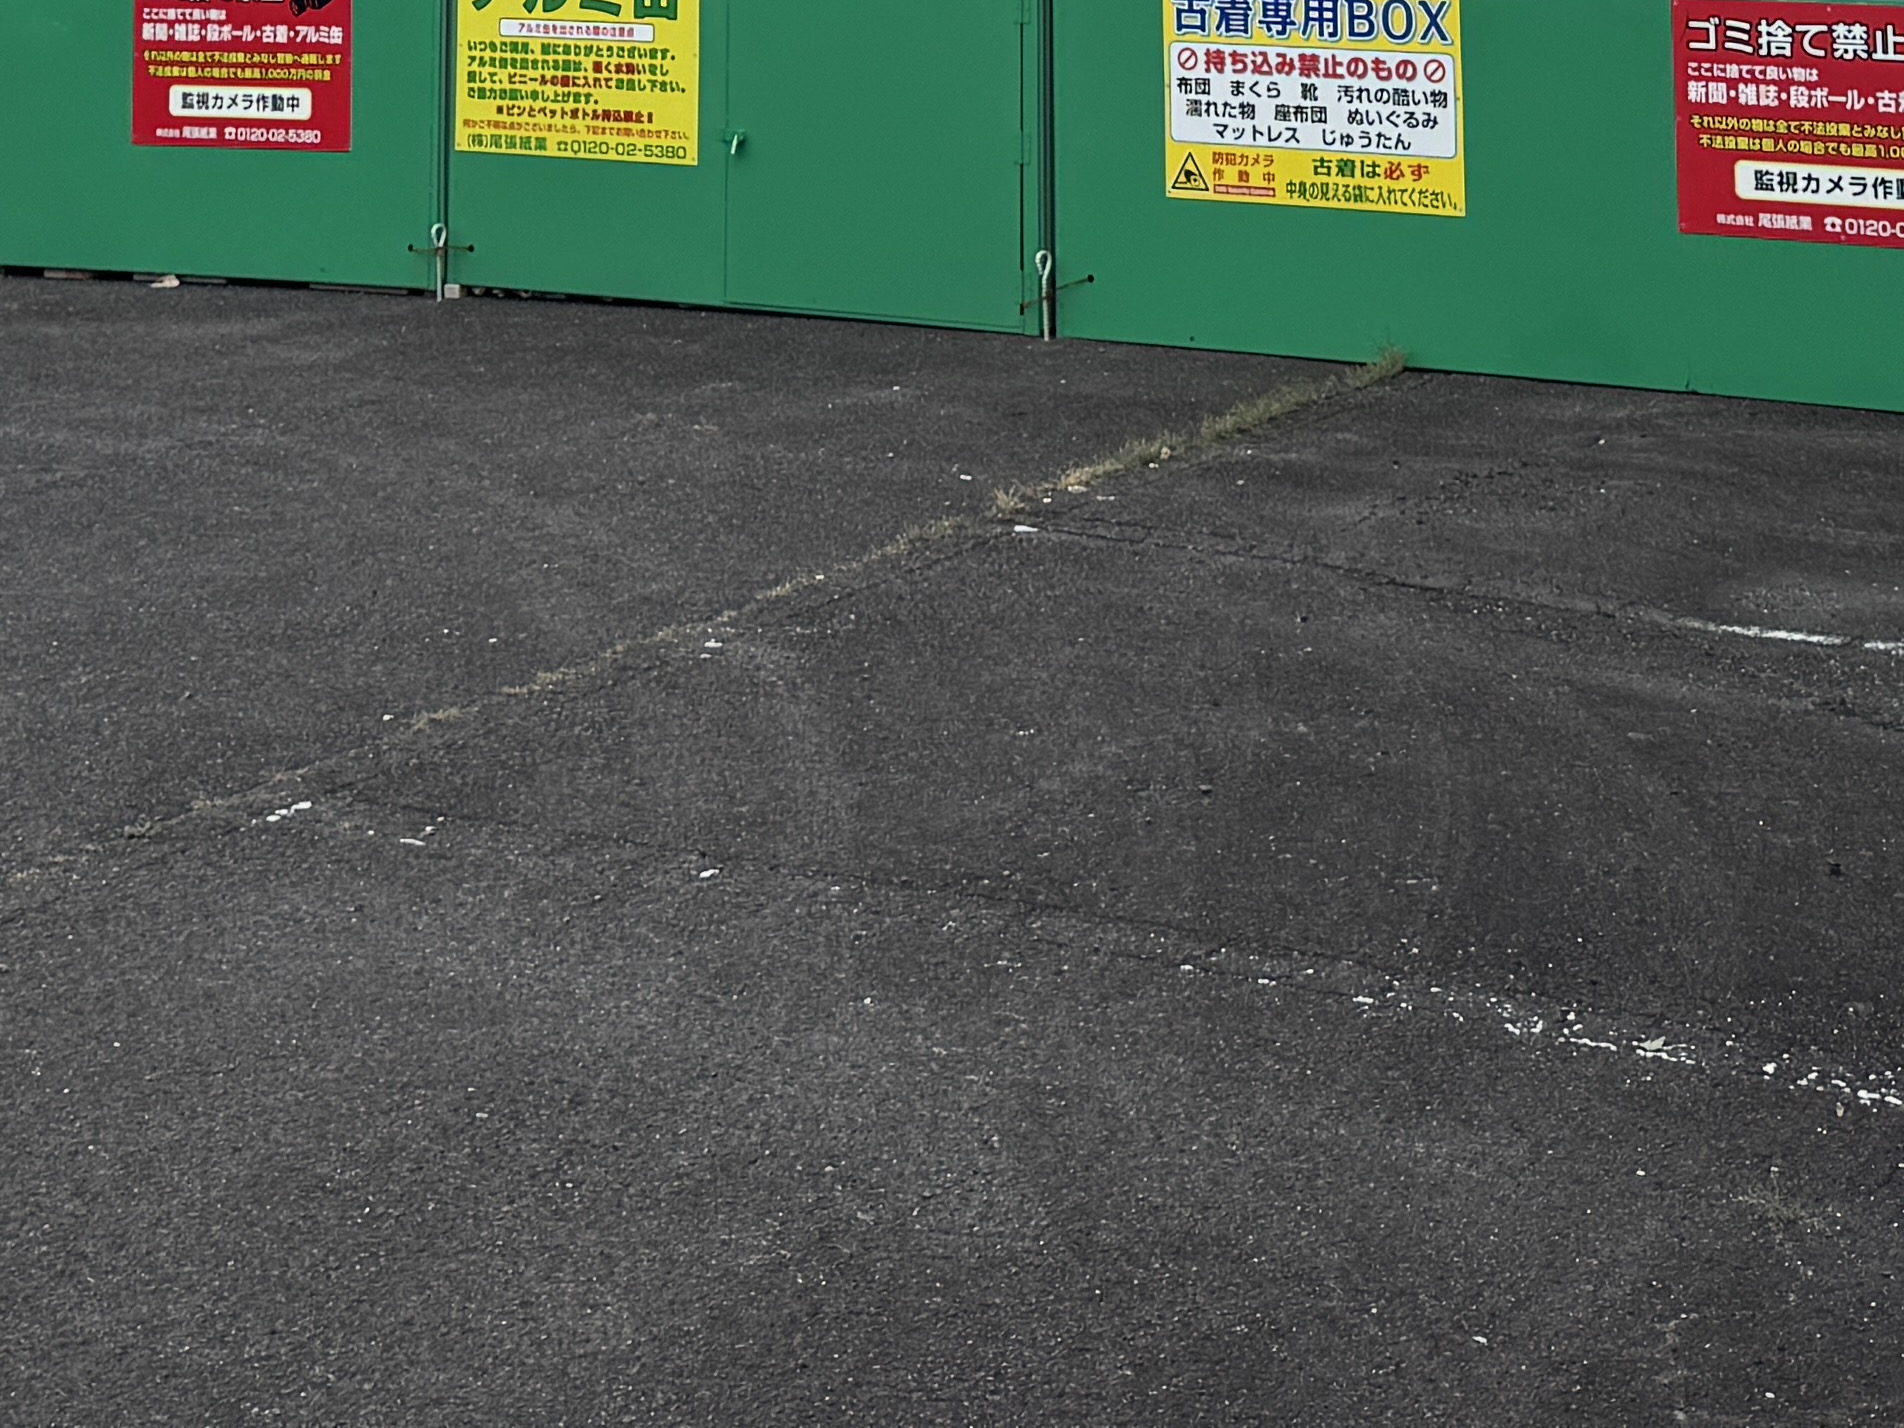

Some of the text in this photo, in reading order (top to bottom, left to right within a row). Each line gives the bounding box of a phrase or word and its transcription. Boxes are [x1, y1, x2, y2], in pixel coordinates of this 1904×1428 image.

[142, 23, 343, 44] 新聞・雑誌・段ボール・古着・アルミ缶
[1204, 48, 1417, 82] 持ち込み禁止のもの
[1687, 62, 1819, 82] ここに捨てて良い物は
[181, 91, 300, 112] 監視カメラ作動中
[1177, 77, 1211, 95] 布団
[1230, 81, 1281, 98] まくら
[1337, 85, 1448, 109] 汚れの酷い物
[1274, 104, 1327, 124] 座布団
[1347, 110, 1439, 129] ぬいぐるみ
[1212, 122, 1411, 150] マットレス じゅうたん
[570, 140, 687, 160] 0120-02-5380
[1212, 151, 1274, 166] 防犯カメラ
[1312, 157, 1430, 181] 古着は必ず
[1716, 213, 1754, 227] 株式会社
